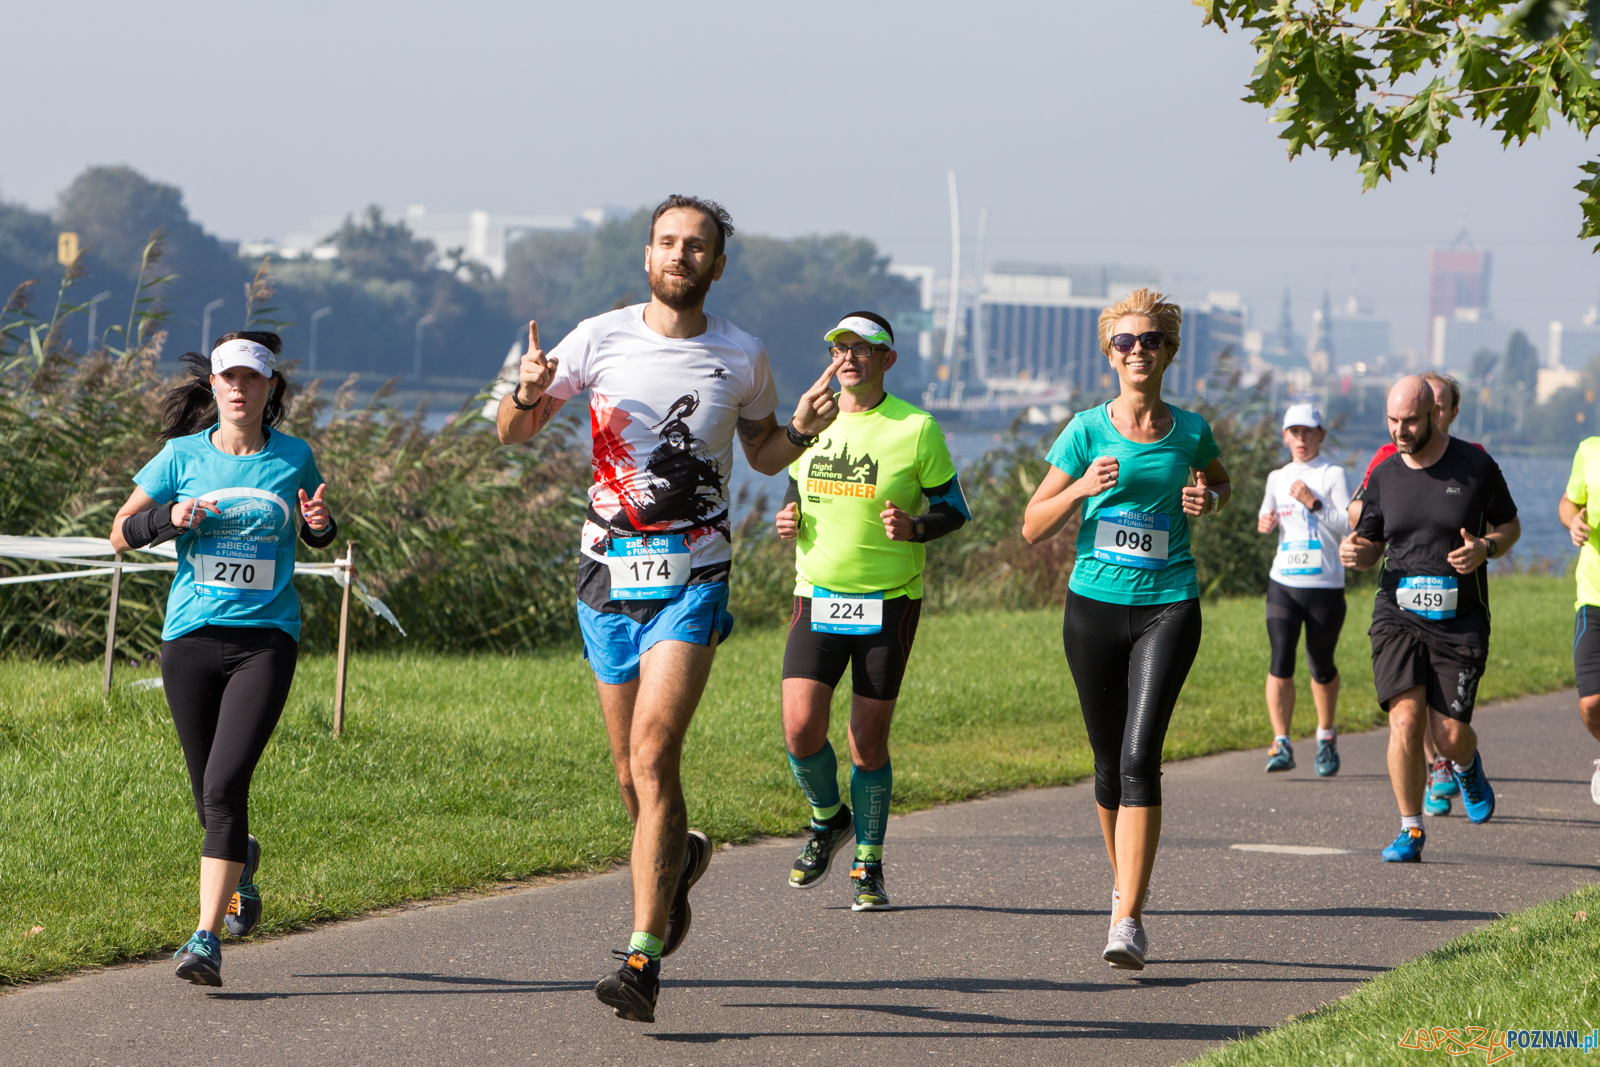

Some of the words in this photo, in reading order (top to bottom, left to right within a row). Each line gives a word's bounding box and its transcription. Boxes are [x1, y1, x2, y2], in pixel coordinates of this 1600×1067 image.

[813, 463, 833, 471] night
[811, 470, 843, 479] runners
[806, 479, 876, 499] FINISHER
[1119, 510, 1155, 523] zaBIEGaj
[216, 541, 258, 553] zaBIEGaj
[625, 537, 669, 549] zaBEGaj
[1115, 529, 1153, 552] 098
[221, 549, 257, 558] FUNdusze
[1288, 553, 1309, 565] 062
[213, 561, 256, 584] 270
[629, 559, 671, 581] 174
[1412, 592, 1443, 607] 459
[829, 602, 865, 620] 224
